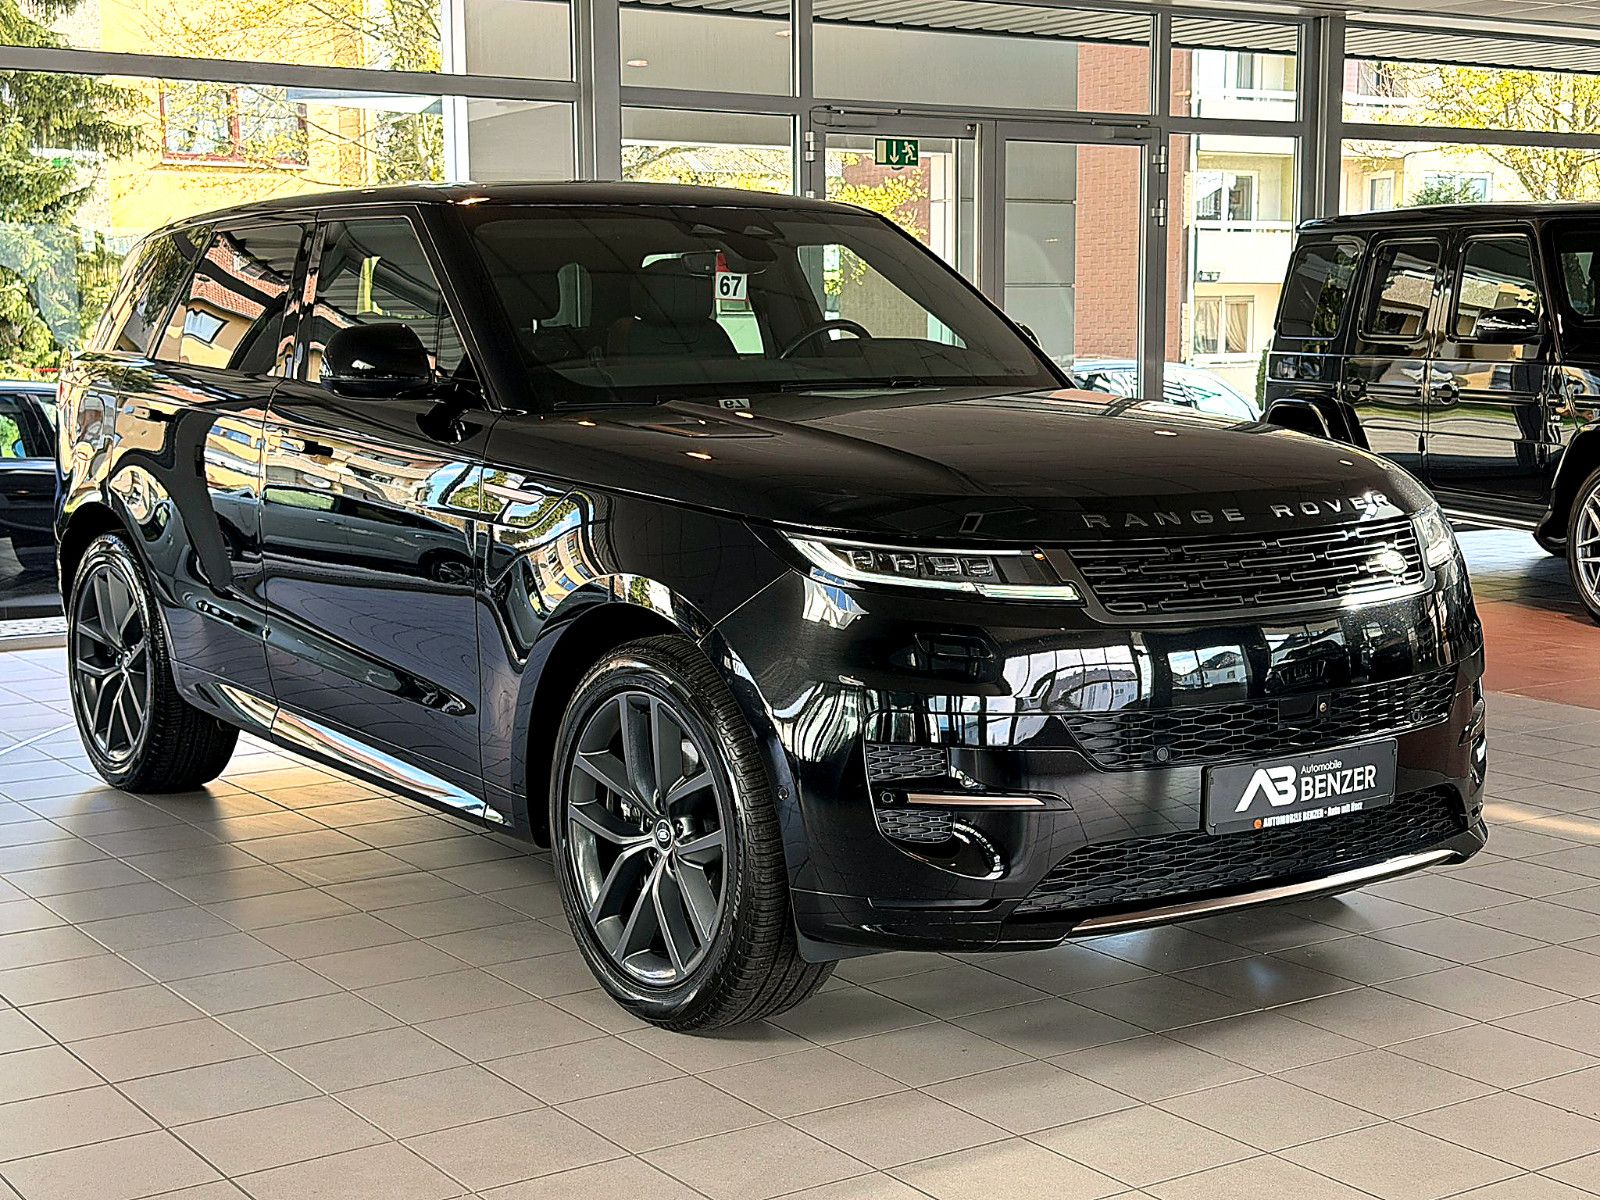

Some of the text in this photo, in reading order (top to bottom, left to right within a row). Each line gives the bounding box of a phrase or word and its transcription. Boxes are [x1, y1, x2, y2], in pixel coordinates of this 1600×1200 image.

[719, 275, 742, 297] 67
[1081, 493, 1391, 529] RANGE ROVER
[1300, 759, 1342, 775] Automobile
[1300, 764, 1377, 802] BENZER
